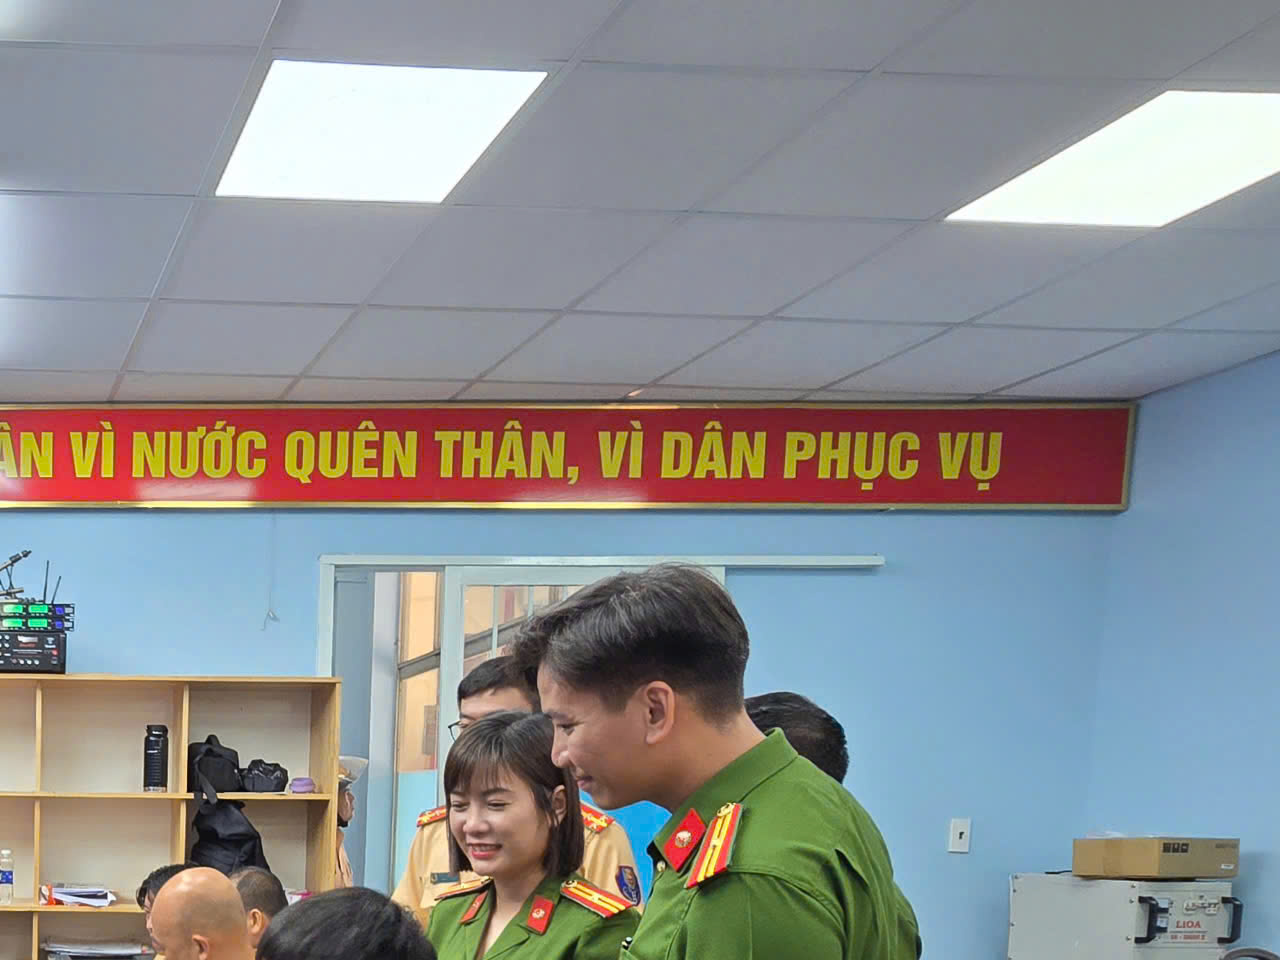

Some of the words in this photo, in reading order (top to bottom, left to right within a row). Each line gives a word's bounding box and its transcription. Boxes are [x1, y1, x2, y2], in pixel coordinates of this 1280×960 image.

[70, 421, 115, 478] VÌ
[132, 421, 267, 479] NƯỚC
[285, 421, 418, 483] QUÊN
[435, 421, 578, 484] THÂN,
[597, 421, 643, 478] VÌ
[660, 421, 766, 478] DÂN
[783, 431, 920, 491] PHỤC
[940, 431, 1003, 491] VỤ
